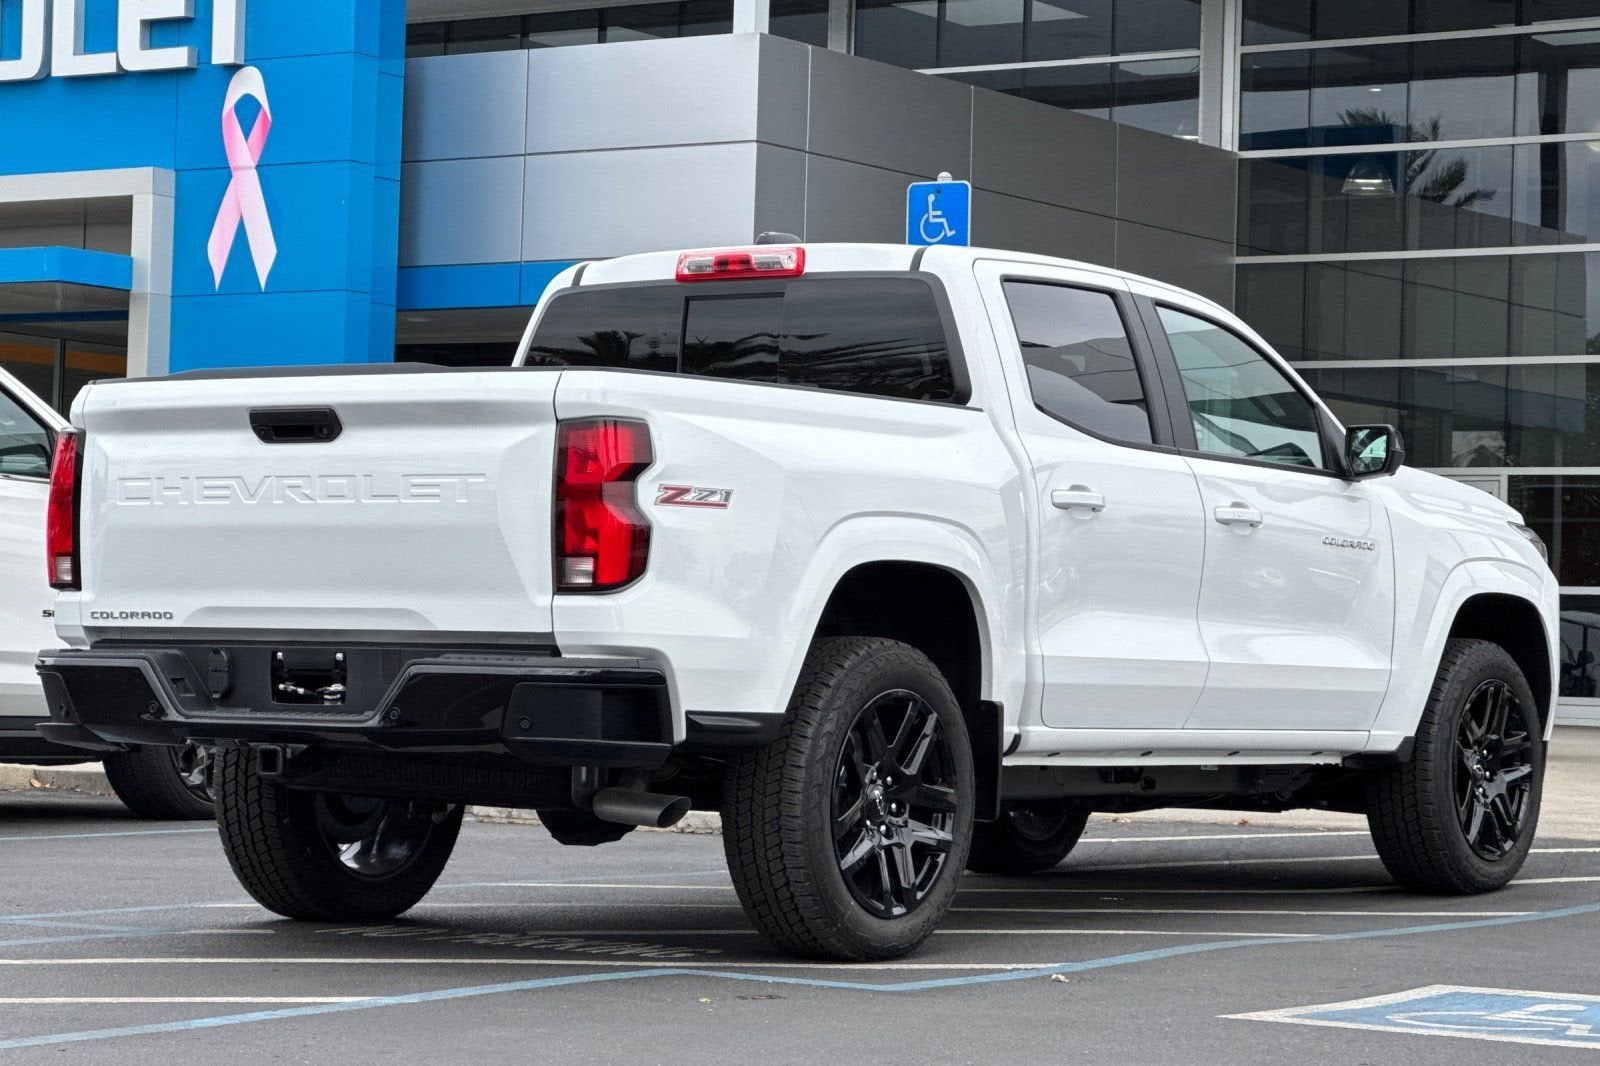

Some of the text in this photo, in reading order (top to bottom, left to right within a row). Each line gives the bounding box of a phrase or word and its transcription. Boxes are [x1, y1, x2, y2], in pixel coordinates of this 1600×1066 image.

[116, 473, 486, 505] CHEVROLET
[654, 484, 733, 509] Z71
[1321, 536, 1376, 551] COLORADO
[90, 611, 173, 620] COLORADO
